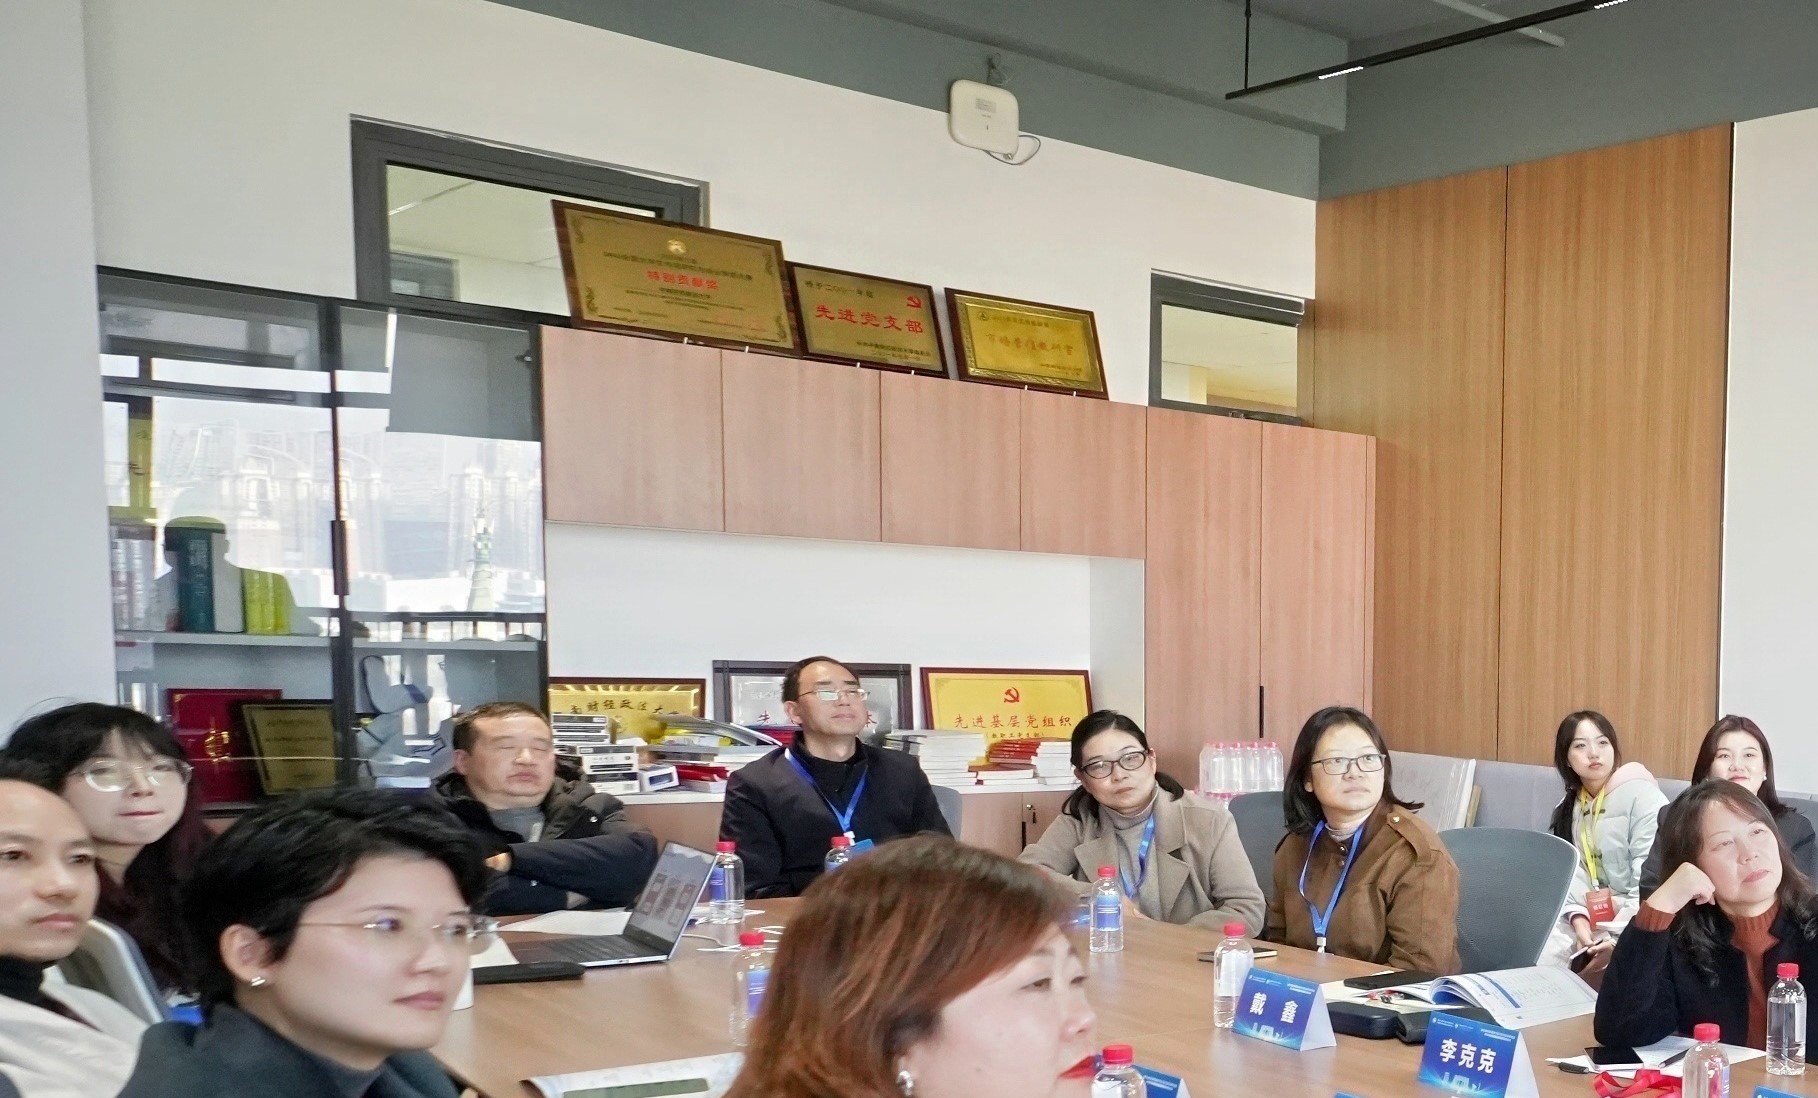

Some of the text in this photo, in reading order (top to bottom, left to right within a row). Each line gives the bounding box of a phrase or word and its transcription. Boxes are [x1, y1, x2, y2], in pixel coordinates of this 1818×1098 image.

[815, 304, 924, 334] 先进党支部
[954, 713, 1073, 730] 先进基层党组织
[1249, 992, 1299, 1024] 戴鑫
[1439, 1038, 1497, 1074] 李克克
